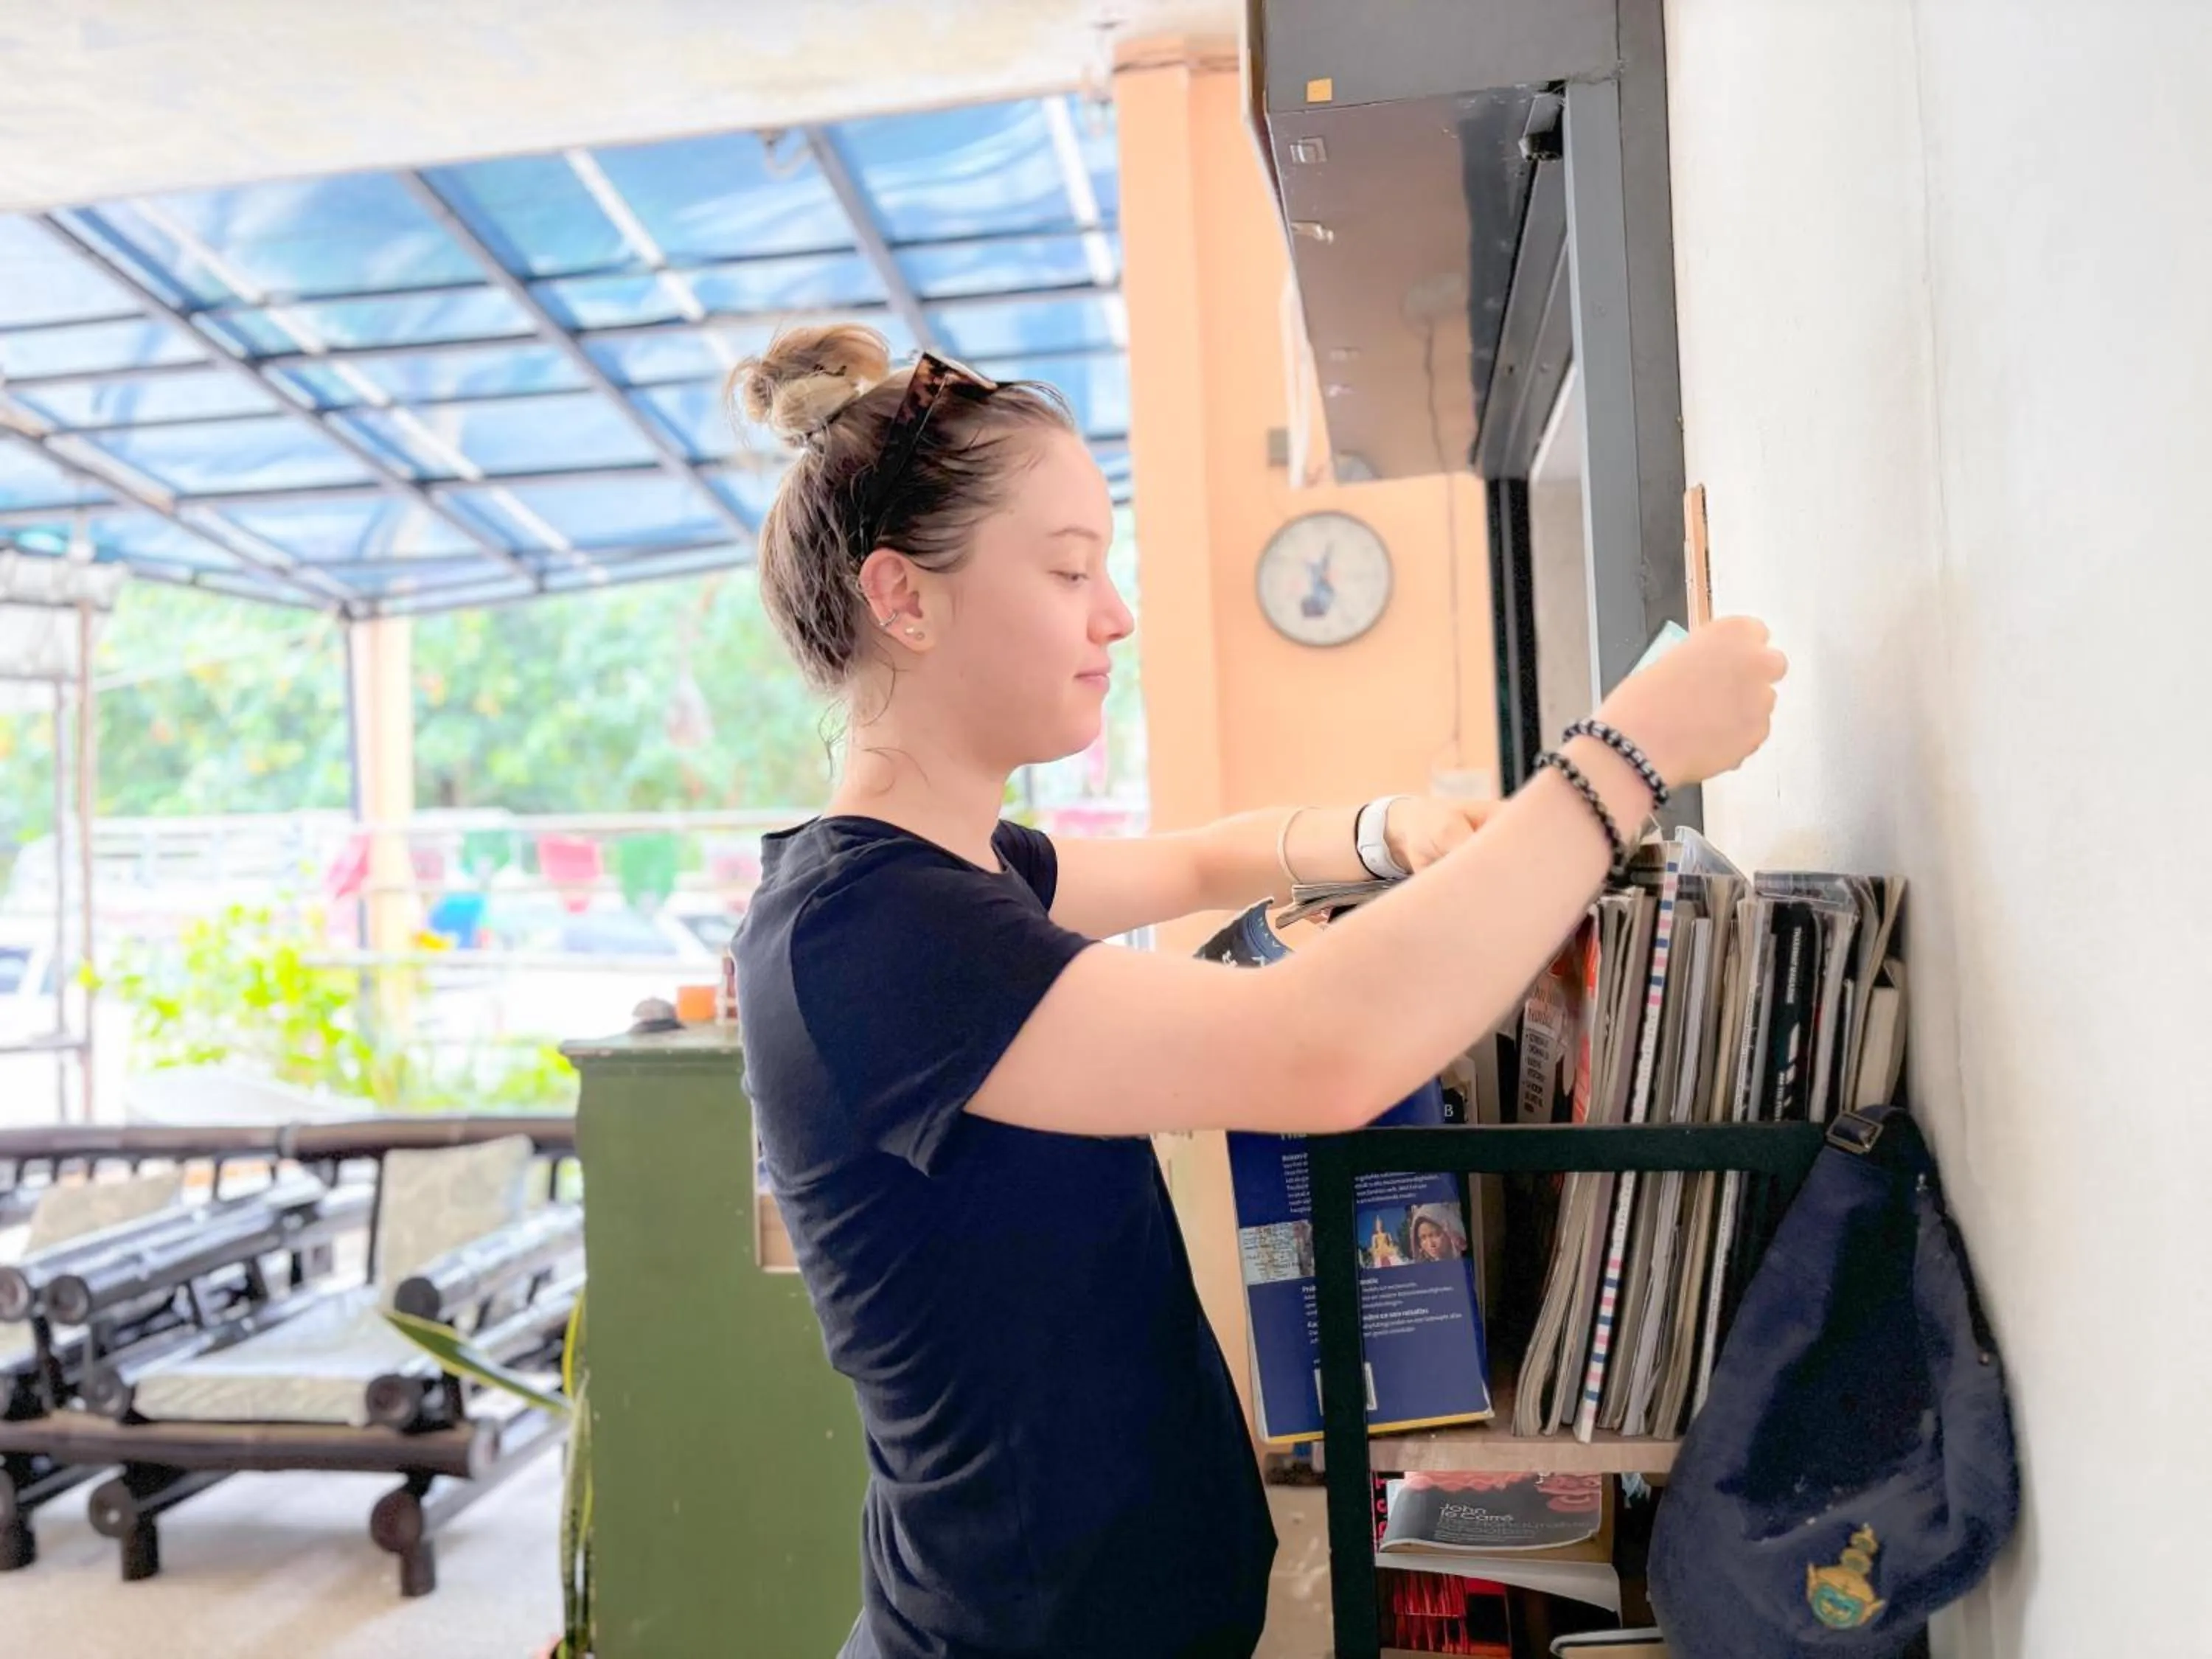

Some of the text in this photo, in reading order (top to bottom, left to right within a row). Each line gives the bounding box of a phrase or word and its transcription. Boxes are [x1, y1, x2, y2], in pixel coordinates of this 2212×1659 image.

[1444, 1104, 1453, 1117] B
[1439, 1503, 1487, 1515] John
[1441, 1508, 1458, 1520] le
